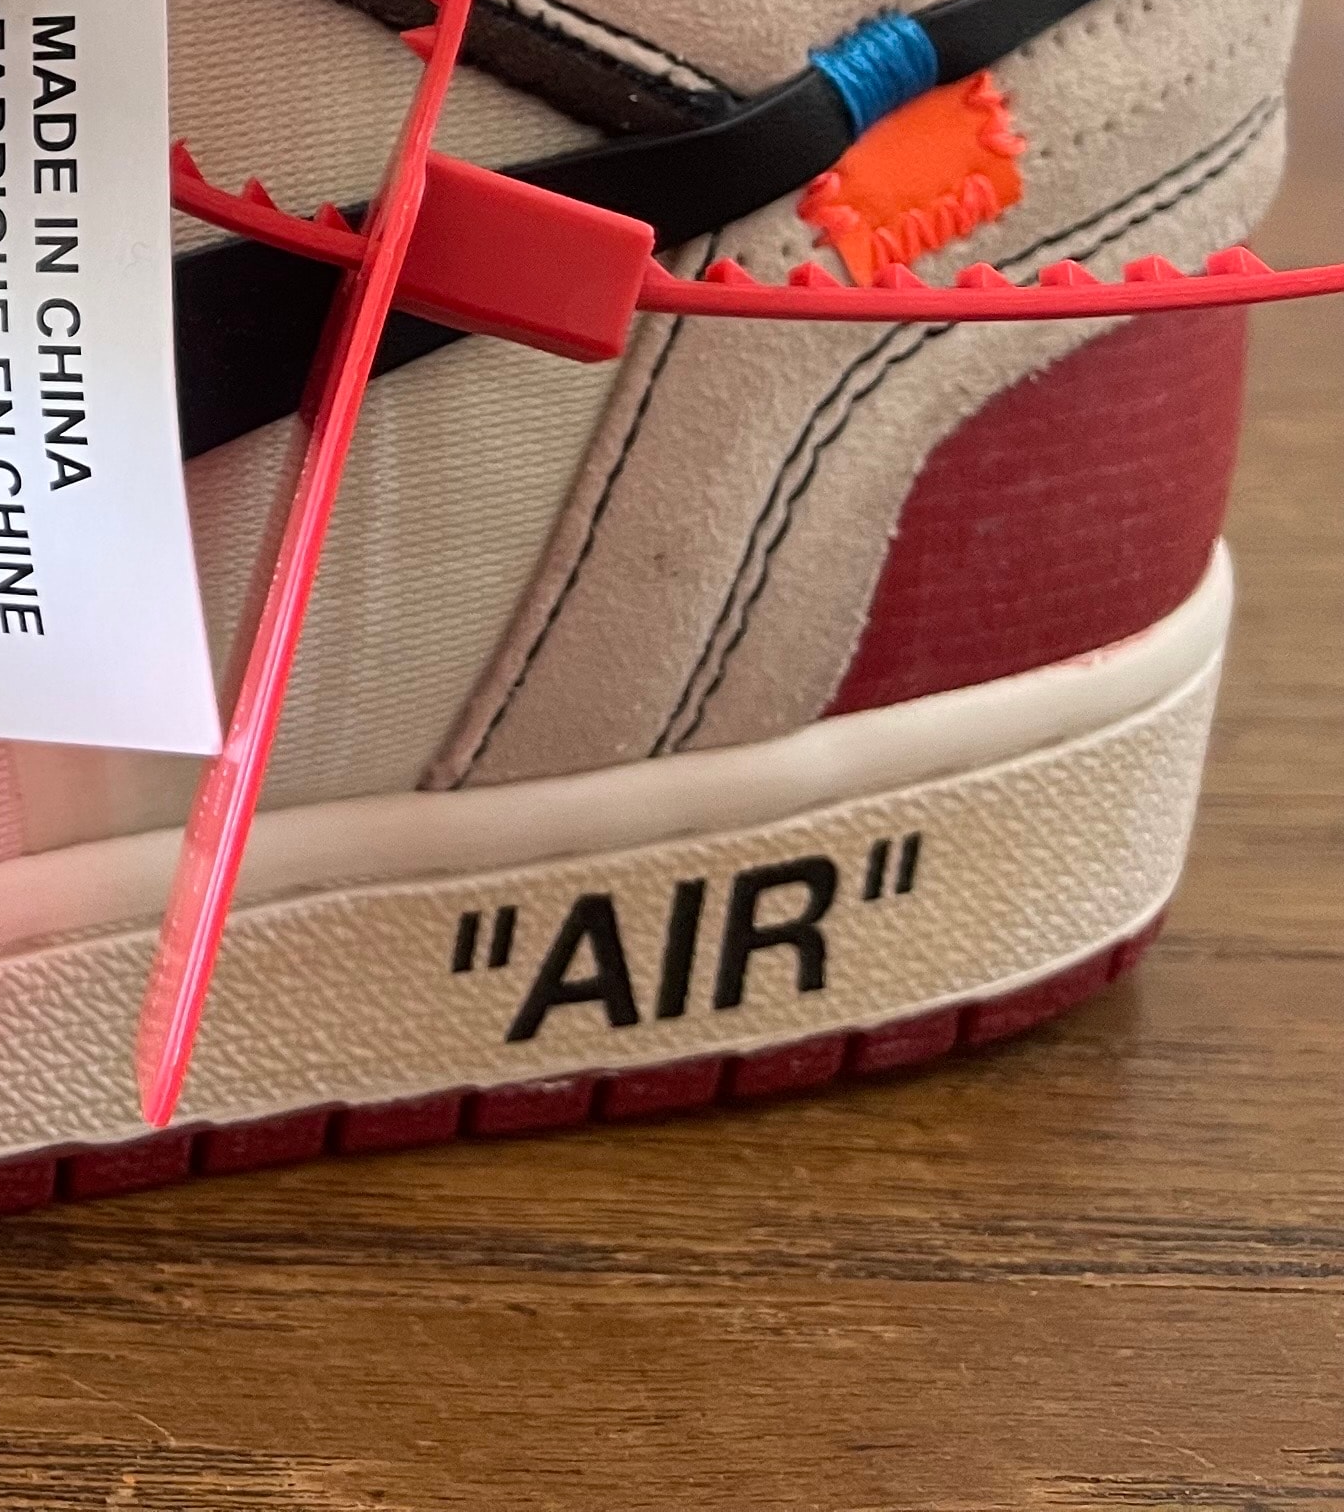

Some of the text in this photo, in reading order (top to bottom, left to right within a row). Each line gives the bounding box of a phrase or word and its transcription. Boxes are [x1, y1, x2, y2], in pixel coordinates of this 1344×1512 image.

[31, 14, 93, 493] MADE IN CHINA
[451, 831, 921, 1044] "AIR"
